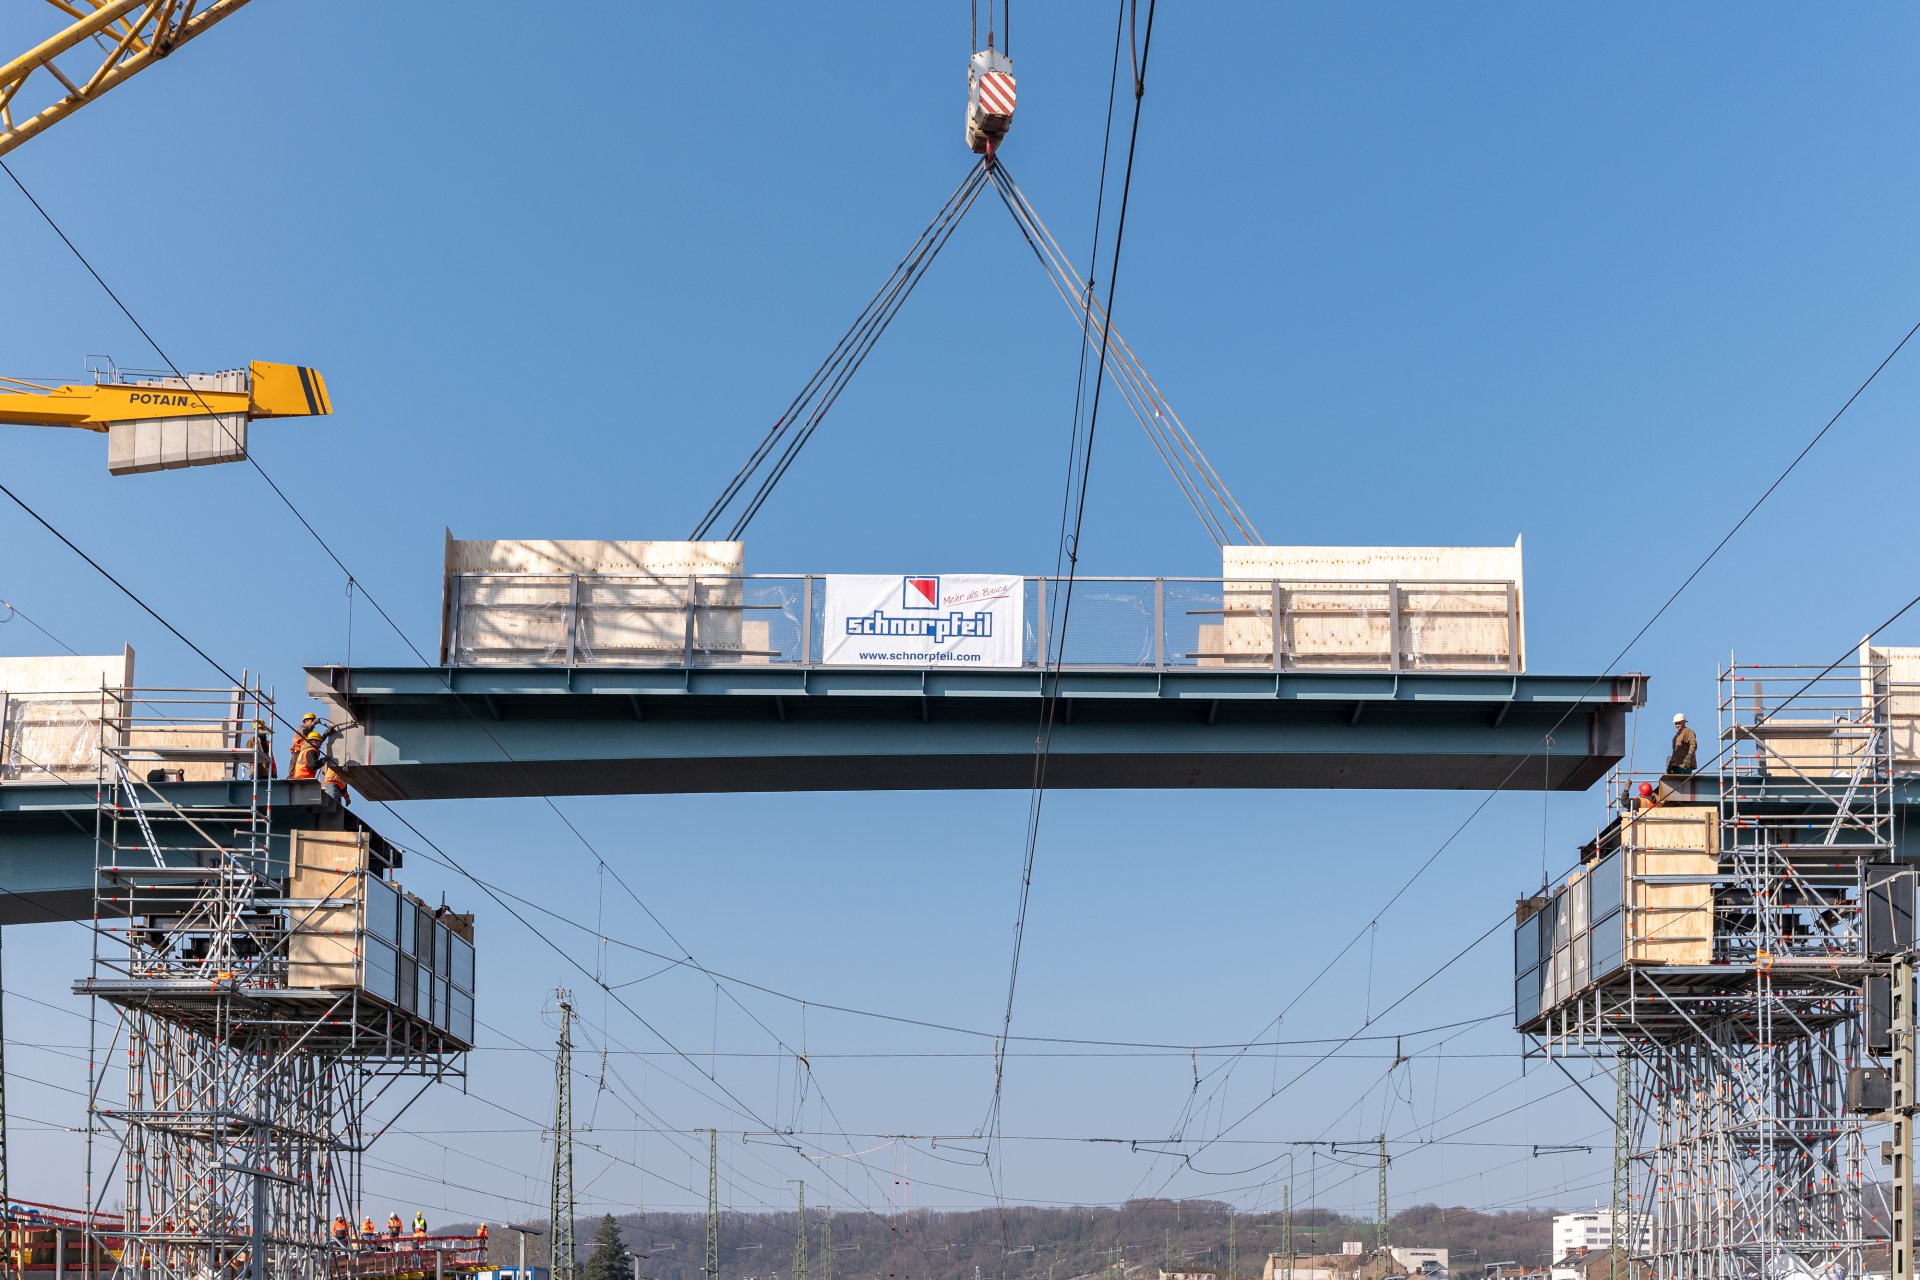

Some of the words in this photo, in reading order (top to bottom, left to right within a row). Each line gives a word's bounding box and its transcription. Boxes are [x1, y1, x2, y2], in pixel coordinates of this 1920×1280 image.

[129, 393, 188, 406] POTAIN
[943, 593, 965, 604] Mehr
[967, 590, 979, 600] als
[846, 610, 992, 643] schnorpfeil
[859, 651, 981, 662] www.schnorpfeil.com
